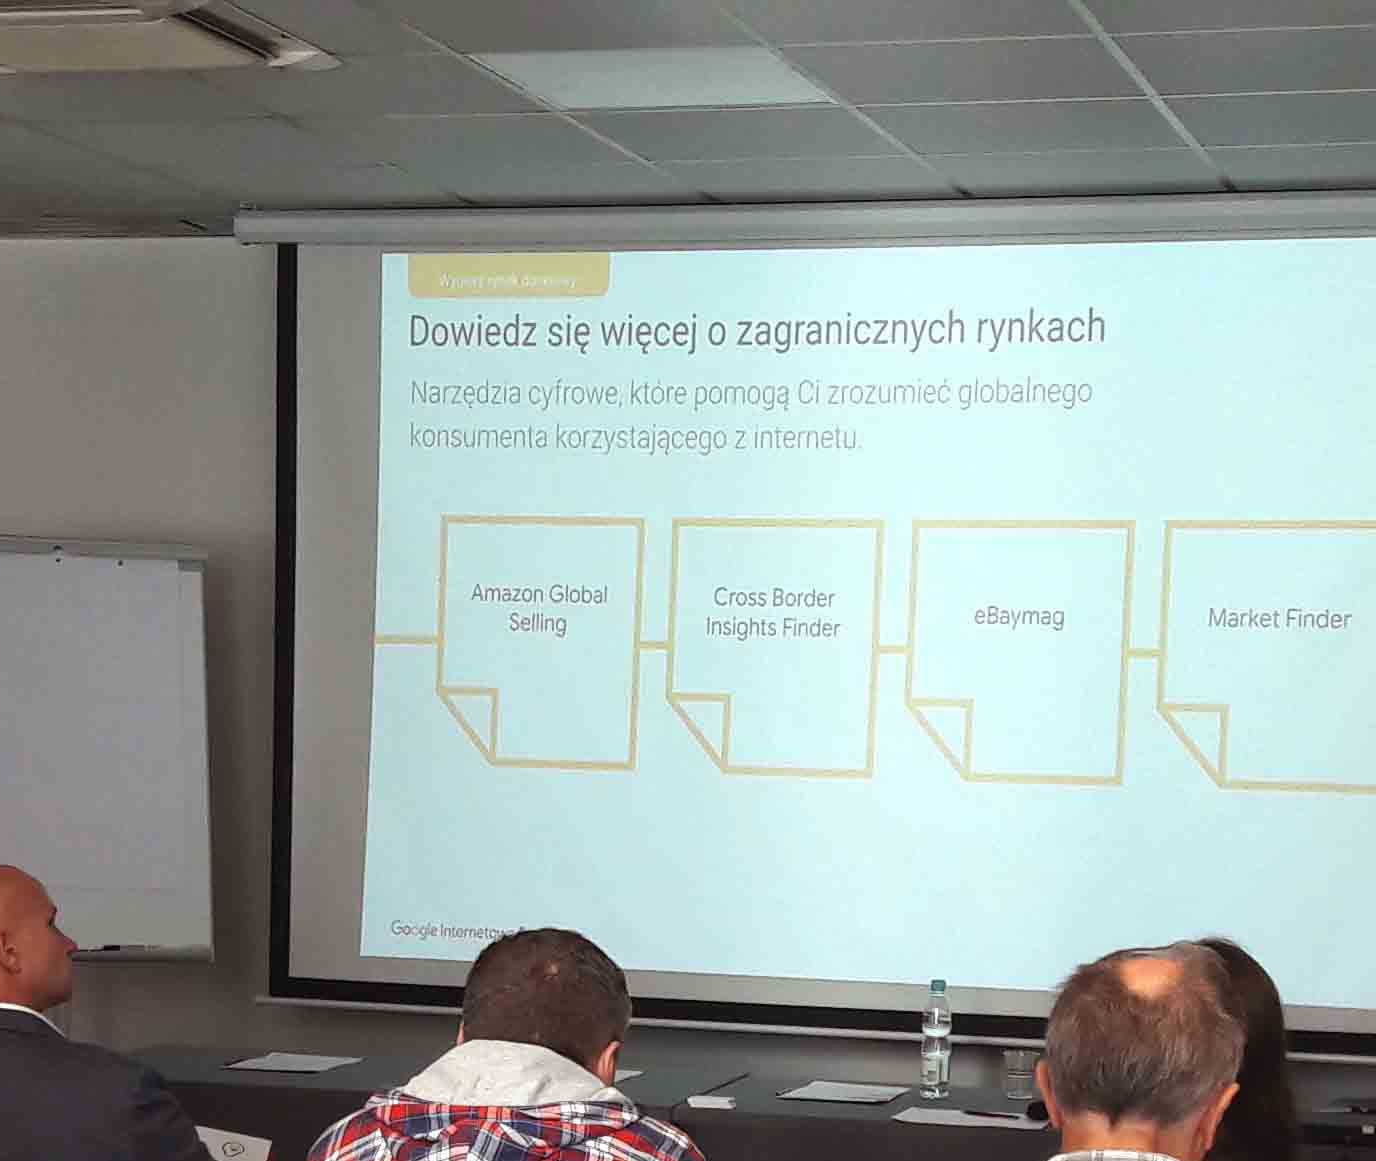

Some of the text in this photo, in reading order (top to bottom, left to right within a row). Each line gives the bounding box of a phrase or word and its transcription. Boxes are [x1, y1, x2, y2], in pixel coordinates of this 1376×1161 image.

[409, 307, 1106, 354] Dowiedz się więcej o zagranicznych rynkach
[410, 376, 1093, 411] Narzędzia cyfrowe, które pomogą Ci zrozumieć globalnego
[408, 423, 863, 456] konsumenta korzystającego z internetu.
[471, 584, 608, 605] Amazon Global
[713, 587, 836, 608] Cross Border
[509, 612, 568, 638] Selling
[705, 617, 842, 641] Insights Finder
[974, 605, 1065, 631] eBaymag
[1208, 607, 1353, 630] Market Finder
[391, 919, 438, 940] Google
